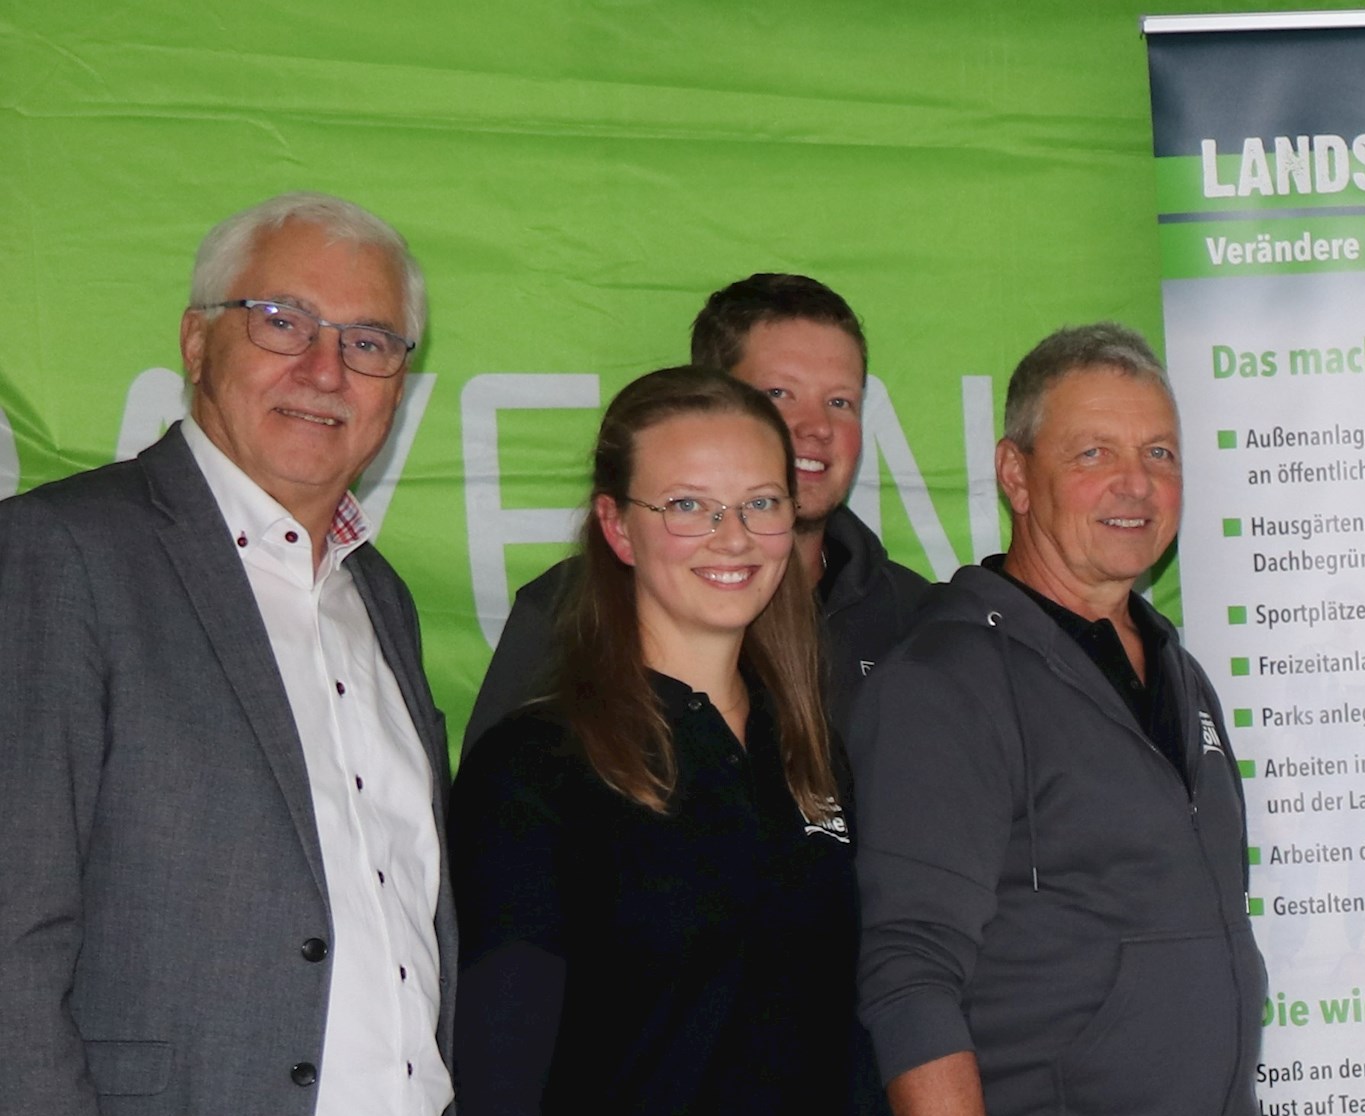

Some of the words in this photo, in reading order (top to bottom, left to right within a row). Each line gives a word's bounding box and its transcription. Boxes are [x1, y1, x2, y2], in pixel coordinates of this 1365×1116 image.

[1206, 231, 1360, 266] Verändere
[1212, 345, 1277, 378] Das
[1248, 470, 1271, 484] an
[1256, 602, 1365, 628] Sportplätze
[1262, 706, 1313, 726] Parks
[1265, 758, 1347, 777] Arbeiten
[1267, 793, 1304, 813] und
[1312, 792, 1342, 811] der
[1270, 845, 1352, 864] Arbeiten
[1274, 895, 1364, 915] Gestalten
[1257, 1060, 1304, 1088] Spaß
[1310, 1066, 1332, 1079] an
[1304, 1095, 1333, 1115] auf
